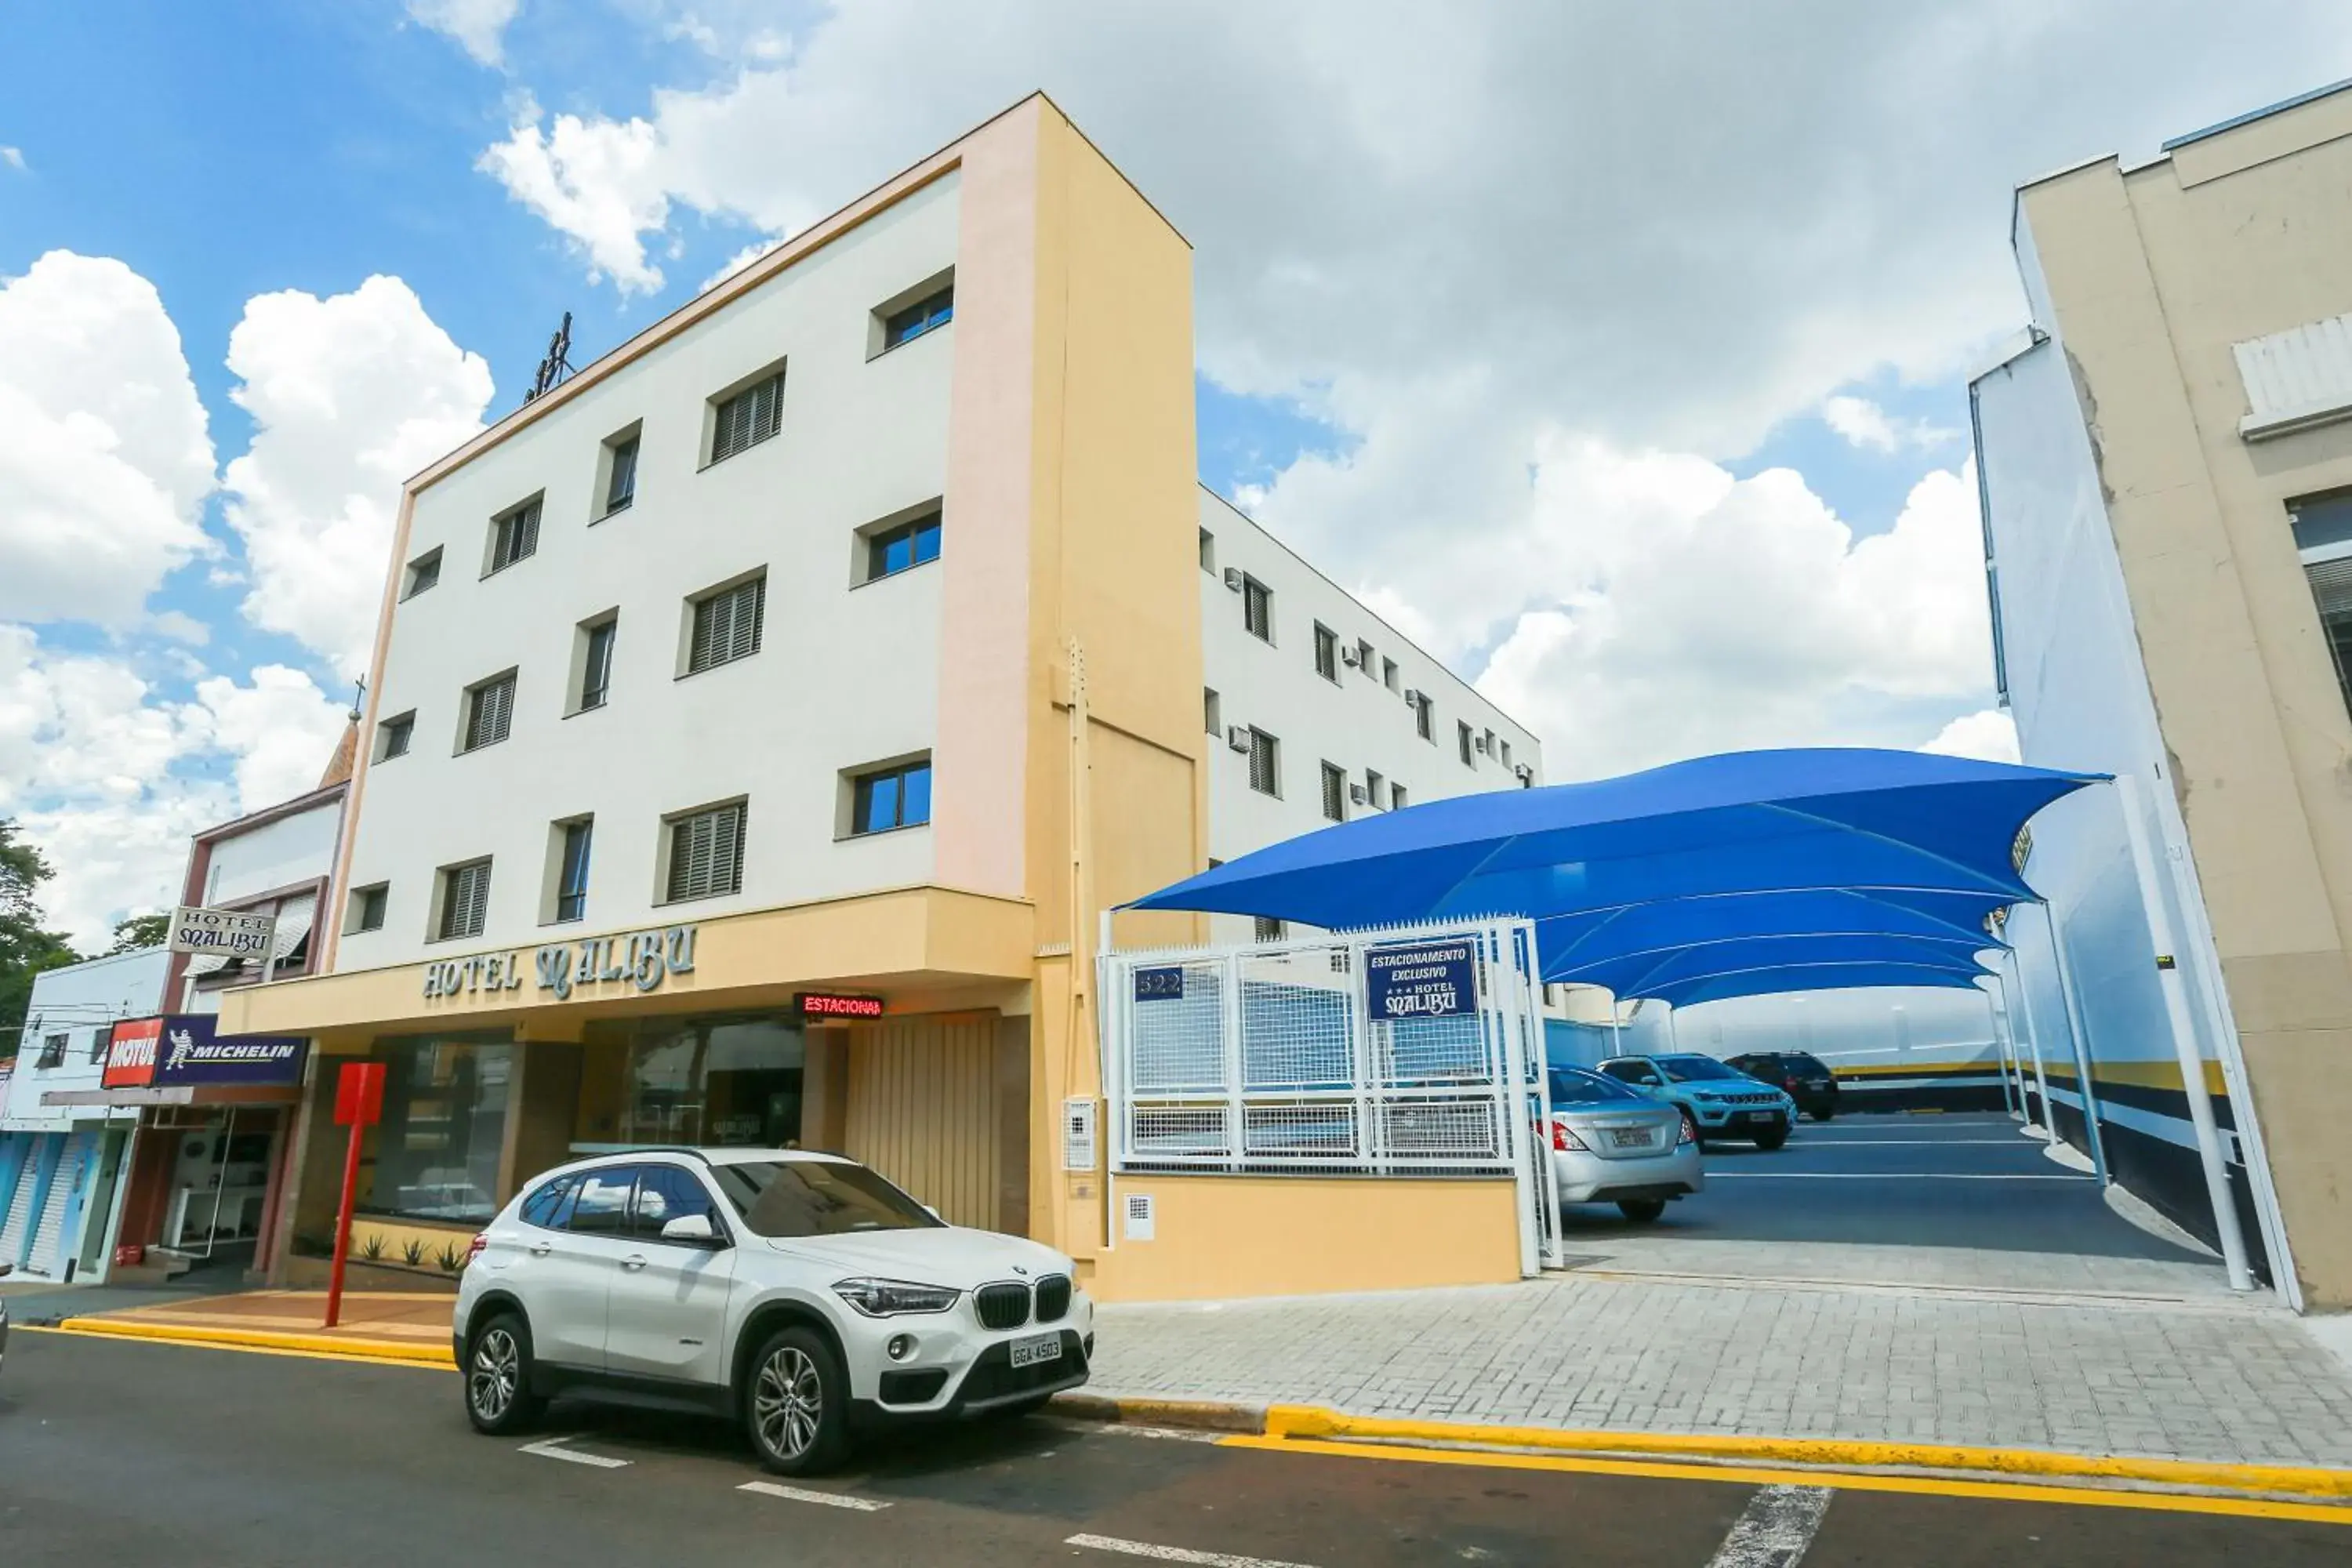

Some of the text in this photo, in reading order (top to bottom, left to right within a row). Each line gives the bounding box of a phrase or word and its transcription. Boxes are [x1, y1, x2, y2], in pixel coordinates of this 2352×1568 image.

[184, 913, 269, 930] HOTEL
[179, 928, 267, 952] MALIBU
[423, 926, 697, 1000] HOTEL MALIBU
[1371, 948, 1465, 968] ESTACIONAMENTO
[1392, 966, 1446, 981] EXCLUSIVO
[1414, 982, 1455, 993] HOTEL
[1385, 992, 1457, 1015] MALIBU
[108, 1037, 157, 1067] MOTUL
[193, 1044, 296, 1059] MICHELIN
